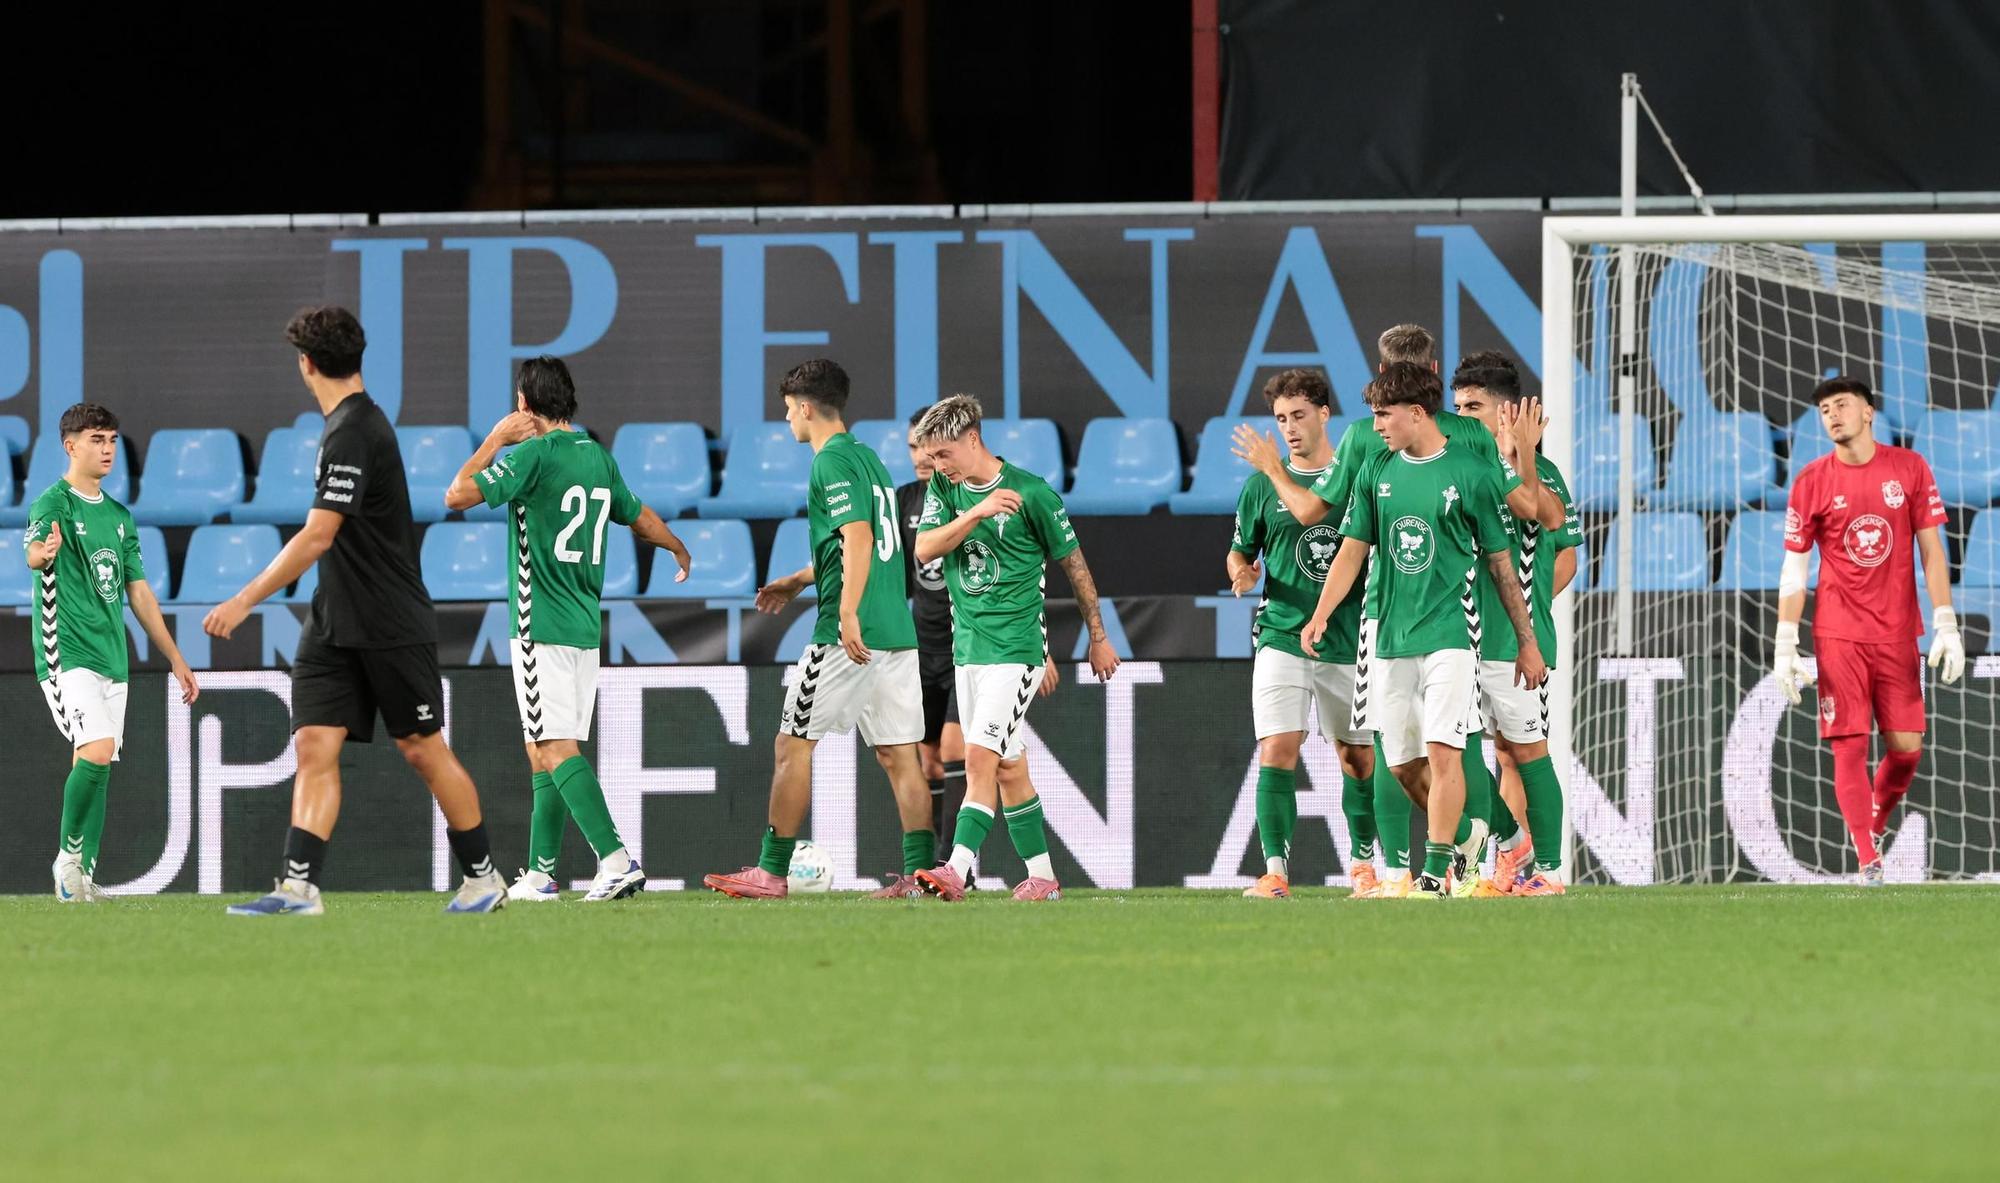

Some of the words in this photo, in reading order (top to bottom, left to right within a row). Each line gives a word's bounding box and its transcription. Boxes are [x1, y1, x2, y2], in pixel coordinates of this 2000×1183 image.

[294, 236, 618, 432] JP
[694, 224, 2000, 430] FINANCI
[553, 484, 612, 565] 27
[1396, 518, 1430, 535] OURENSE
[1852, 517, 1886, 531] OURENSE
[1304, 526, 1342, 543] OURENSE
